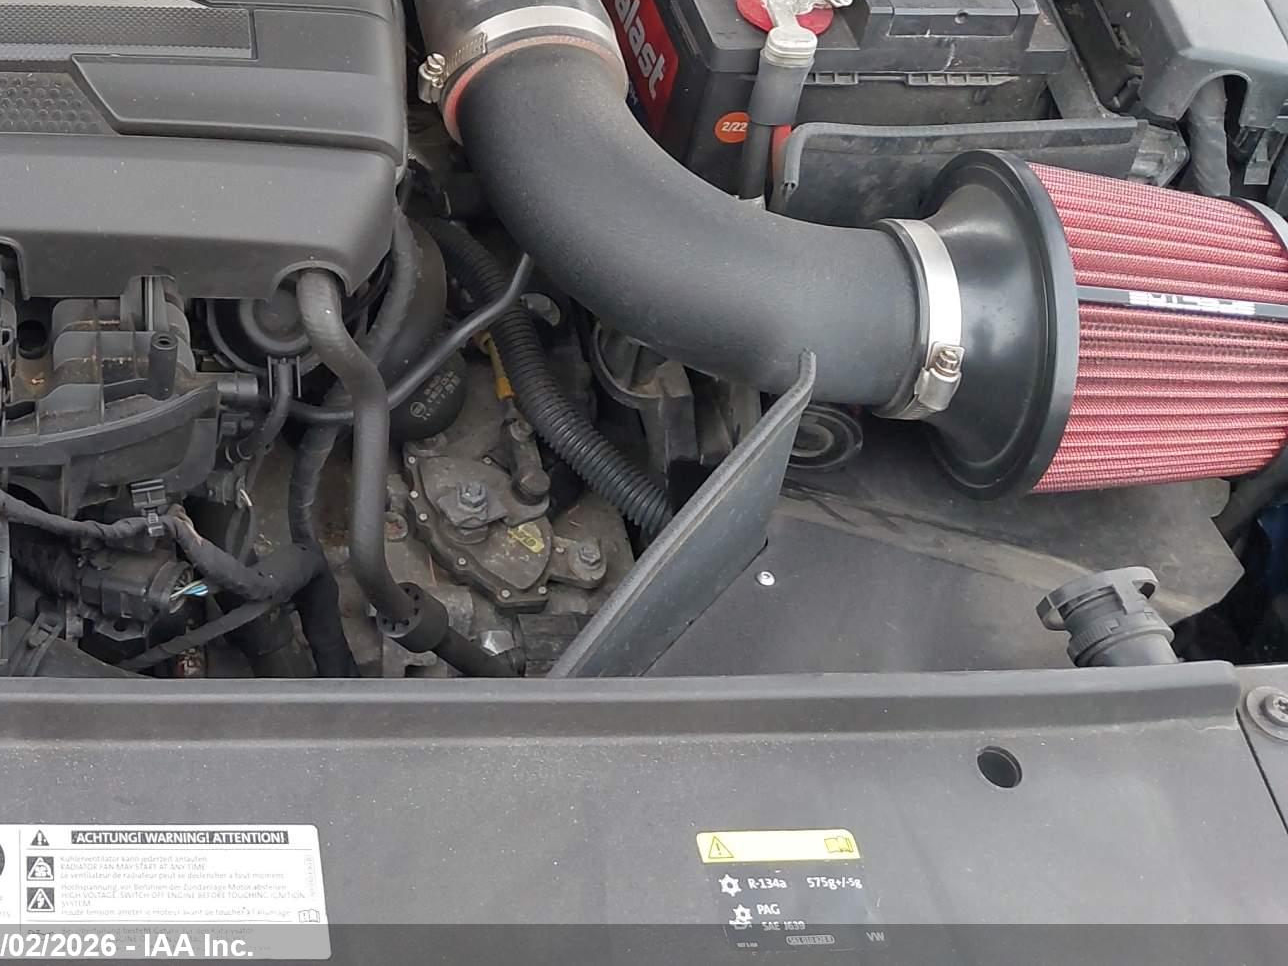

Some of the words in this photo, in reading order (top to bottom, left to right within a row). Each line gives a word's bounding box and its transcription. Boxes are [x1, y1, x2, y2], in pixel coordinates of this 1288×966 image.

[721, 121, 748, 133] 2/22
[76, 832, 142, 843] ACHTUNG!
[144, 832, 209, 844] WARNING!
[212, 832, 285, 844] ATTENTION!
[747, 877, 788, 890] R-134a
[756, 903, 781, 916] PAG
[865, 931, 885, 943] VW
